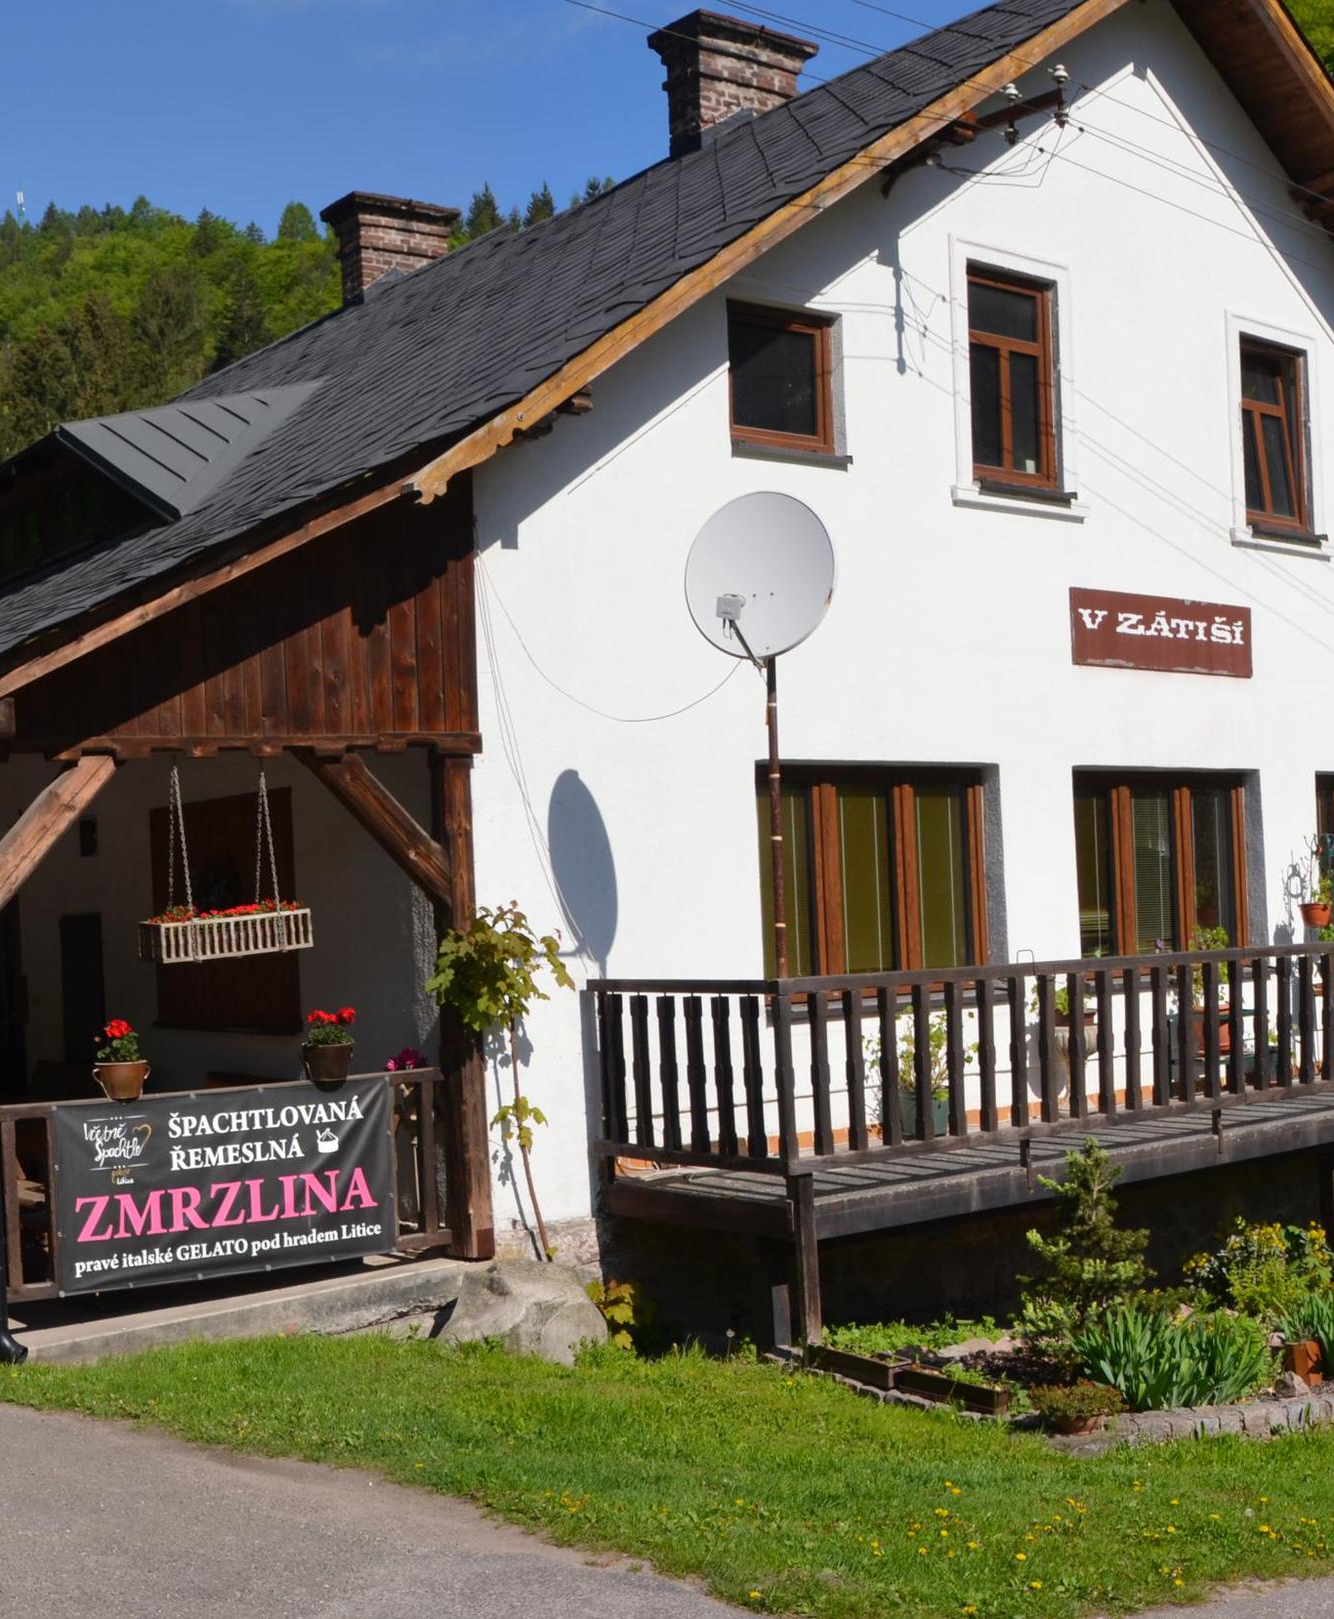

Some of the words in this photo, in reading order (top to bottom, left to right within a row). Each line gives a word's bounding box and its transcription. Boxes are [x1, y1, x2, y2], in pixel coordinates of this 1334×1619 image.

[1078, 608, 1108, 629] V
[1116, 611, 1244, 645] ZÁTIŠÍ
[168, 1095, 364, 1139] ŠPACHTLOVANÁ
[170, 1133, 305, 1171] ŘEMESLNÁ
[75, 1166, 378, 1243] ZMRZLINA
[74, 1253, 120, 1278] pravé
[122, 1247, 173, 1267] italské
[176, 1238, 249, 1261] GELATO
[251, 1233, 281, 1256] pod
[283, 1228, 339, 1248] hradem
[341, 1223, 382, 1240] Litice
